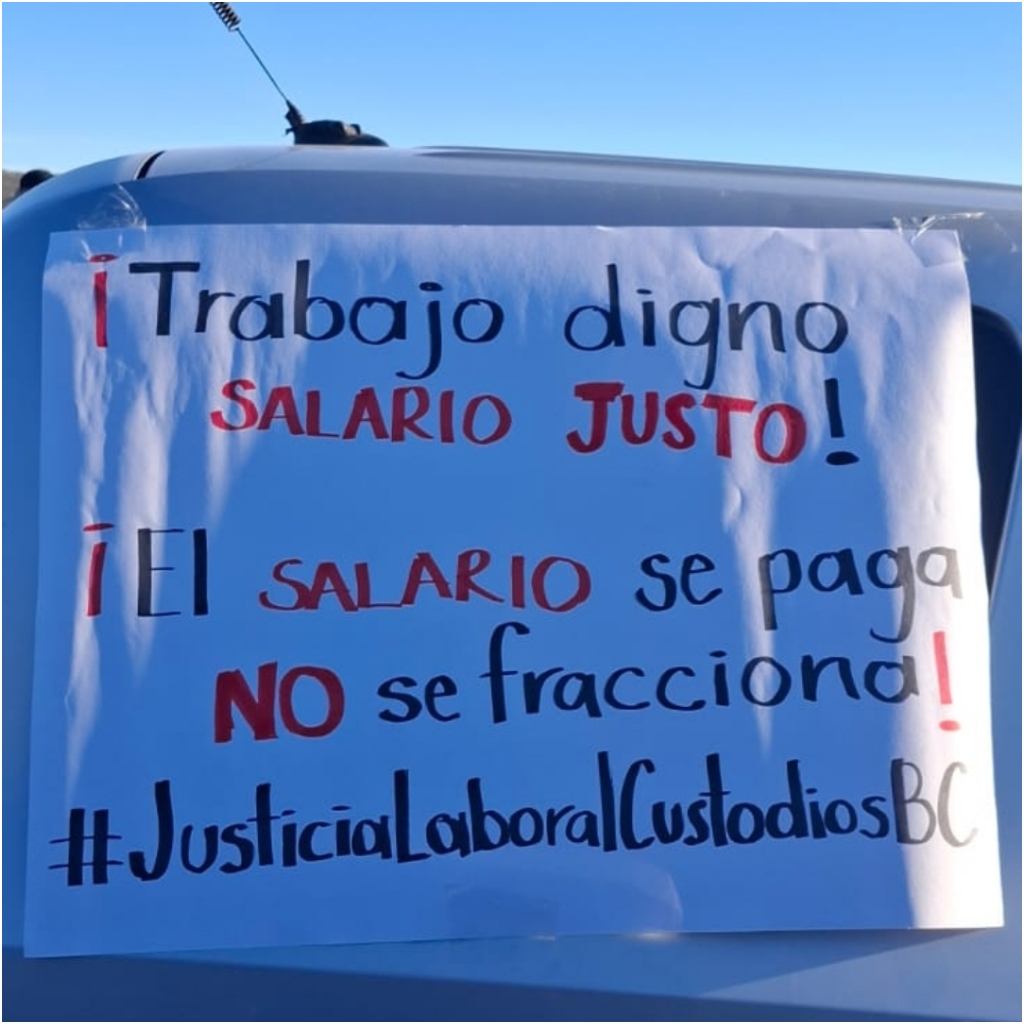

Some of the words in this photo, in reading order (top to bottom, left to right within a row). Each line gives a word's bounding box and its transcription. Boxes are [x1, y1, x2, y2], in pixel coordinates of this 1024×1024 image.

[563, 263, 850, 389] digno
[209, 378, 512, 446] SALARIO
[565, 378, 861, 466] JUSTO!
[257, 547, 593, 613] SALARIO
[633, 552, 723, 611] se
[757, 544, 964, 643] paga
[212, 662, 346, 743] NO
[376, 674, 462, 725] se
[488, 621, 963, 733] fracciona!
[47, 751, 979, 887] #JusticiaLaboralCustodiosBC
